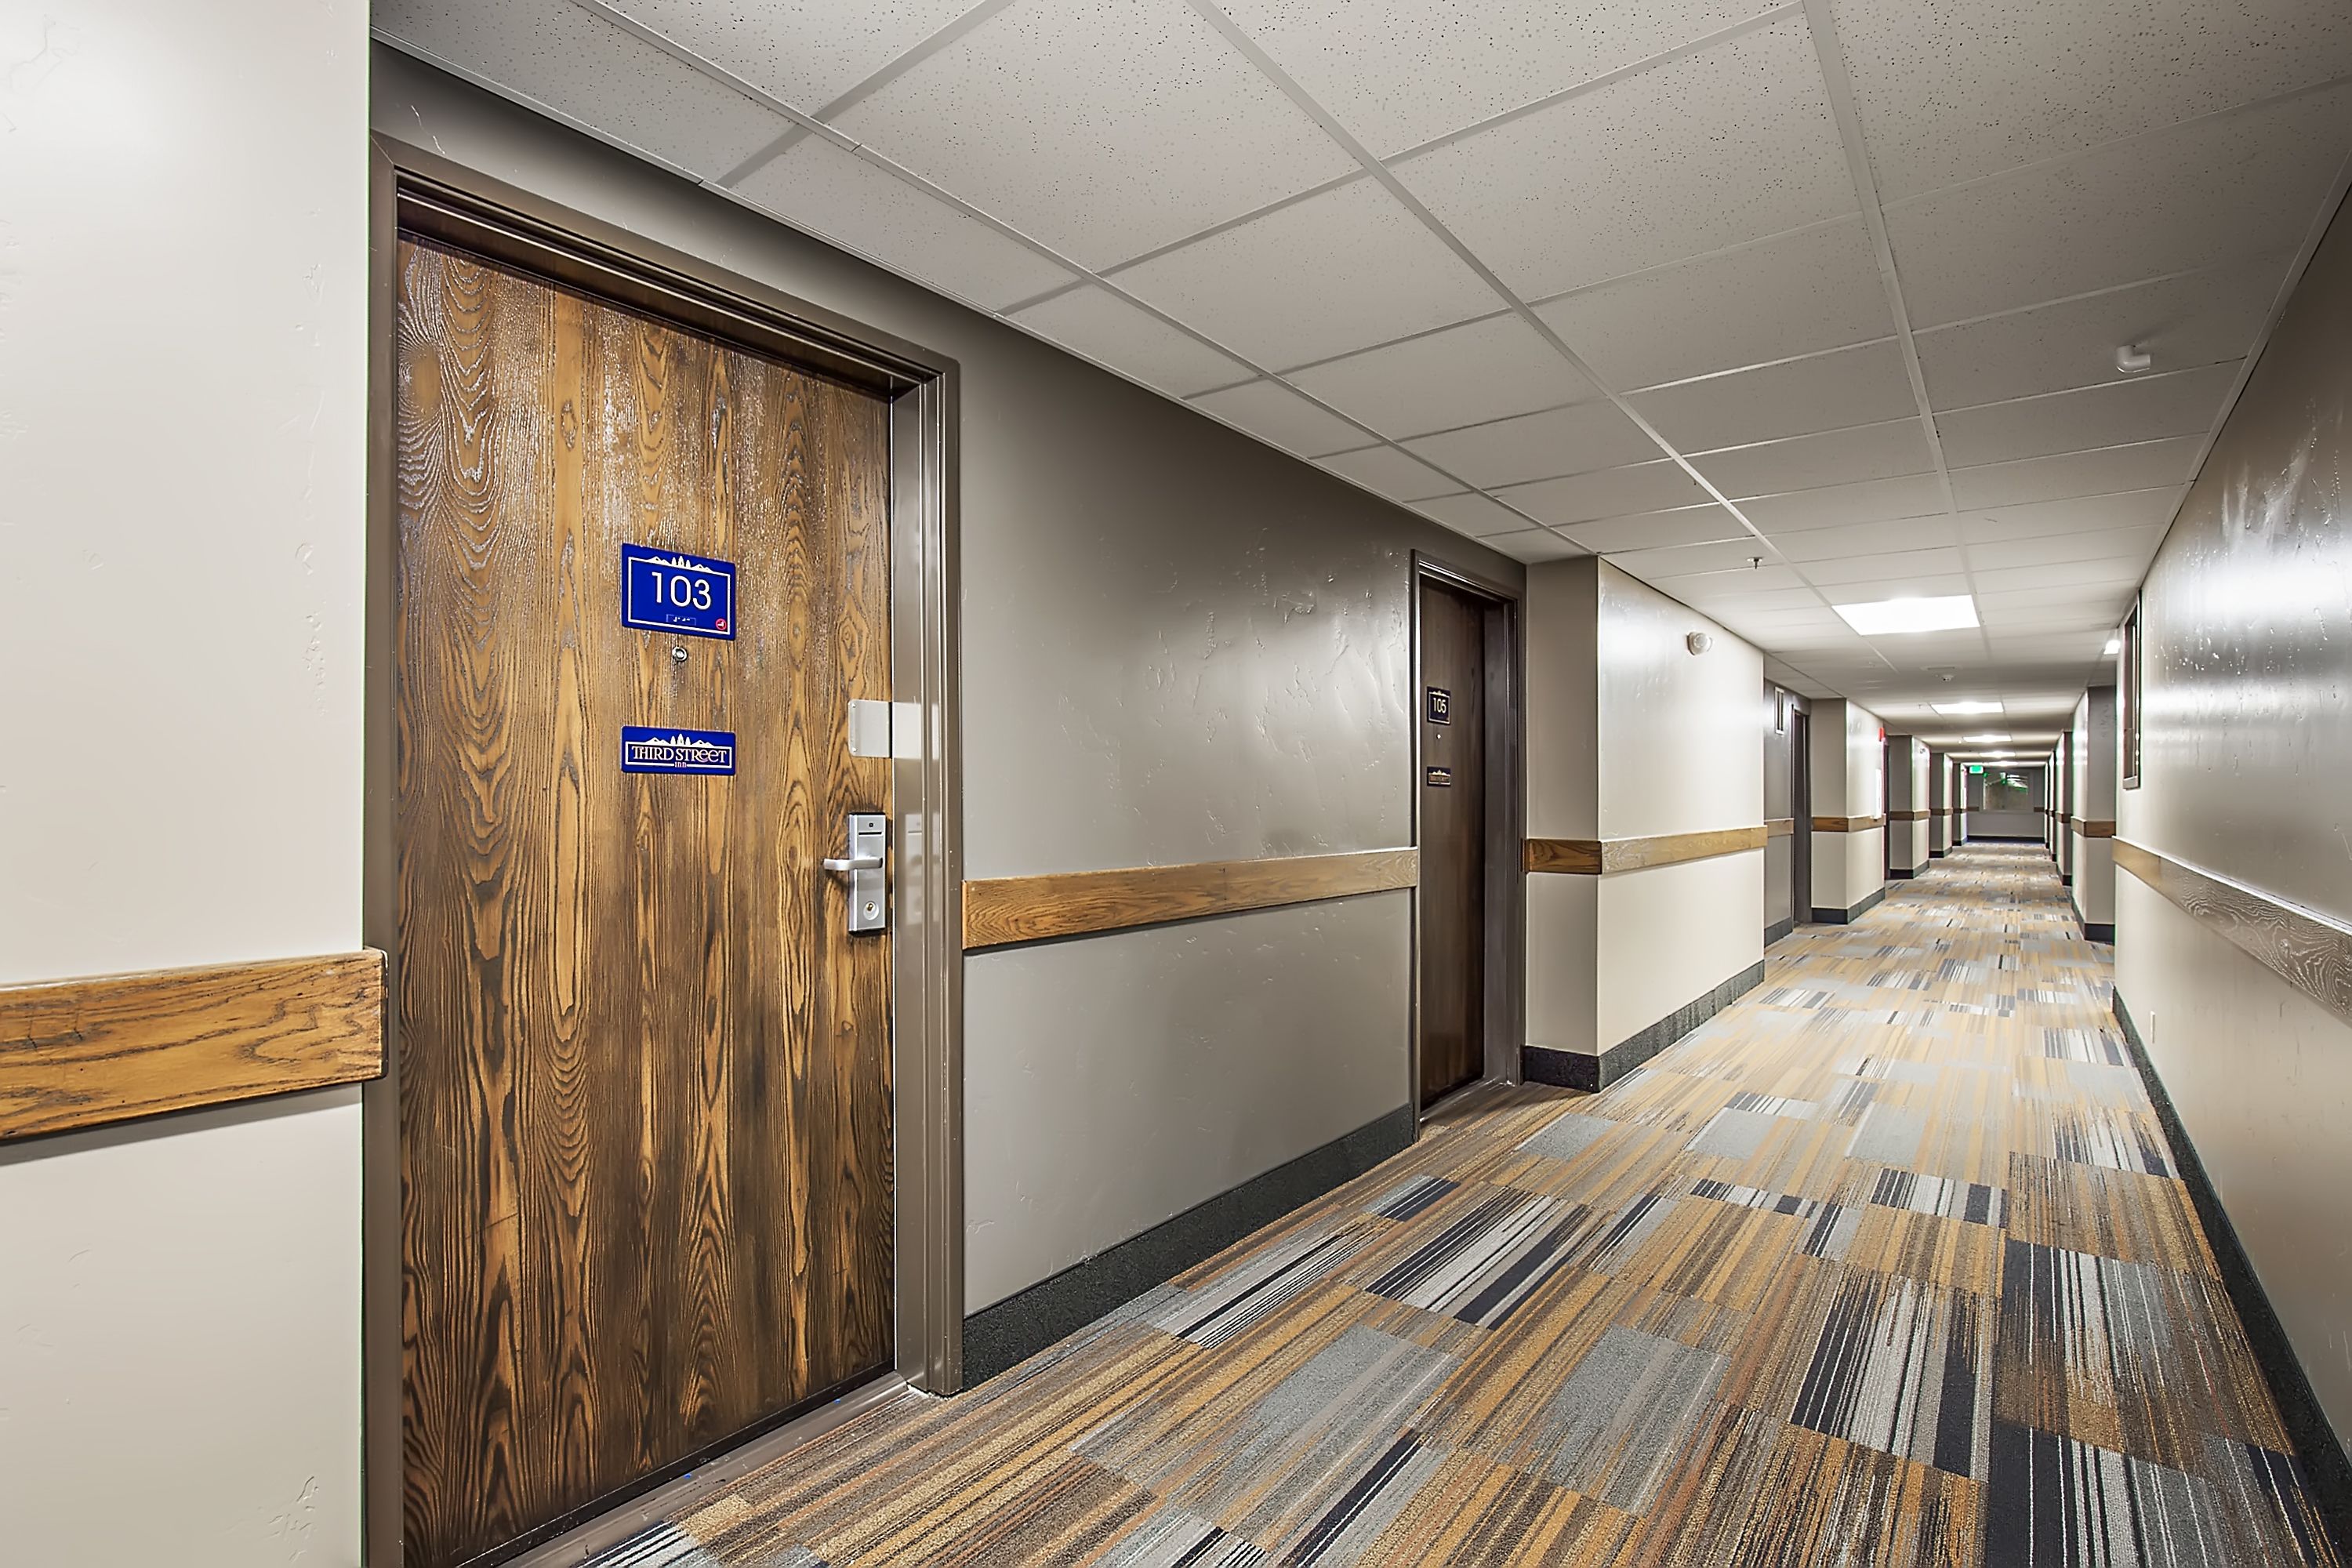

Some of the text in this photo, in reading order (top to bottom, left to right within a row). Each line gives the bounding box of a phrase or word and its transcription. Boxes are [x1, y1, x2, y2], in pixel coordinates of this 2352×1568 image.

[652, 572, 712, 610] 103
[1433, 697, 1446, 713] 105
[631, 746, 674, 760] THIRD
